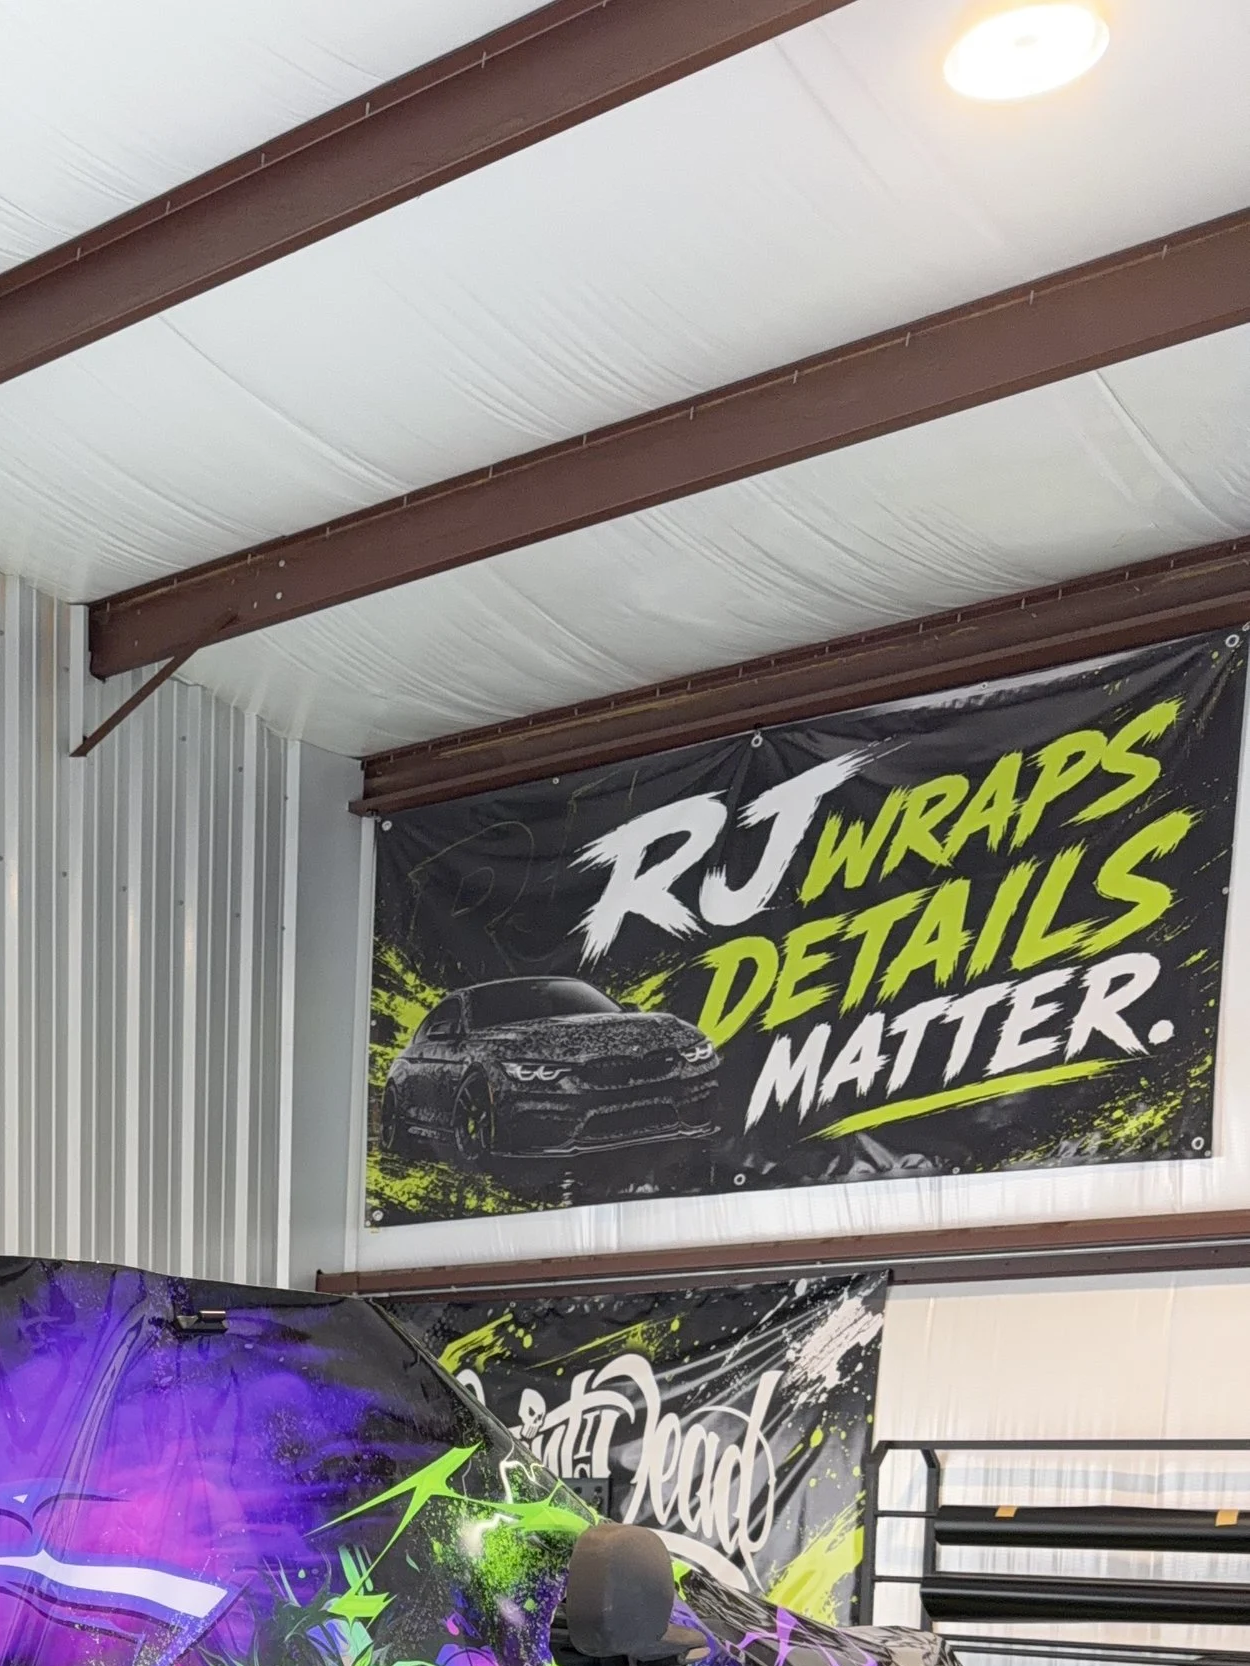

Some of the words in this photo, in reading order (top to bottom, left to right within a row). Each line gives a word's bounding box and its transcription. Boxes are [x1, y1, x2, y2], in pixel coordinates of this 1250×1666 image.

[570, 742, 900, 968] RJ
[796, 698, 1186, 908] WRAPS
[694, 808, 1203, 1047] DETAILS
[745, 952, 1175, 1130] MATTER.
